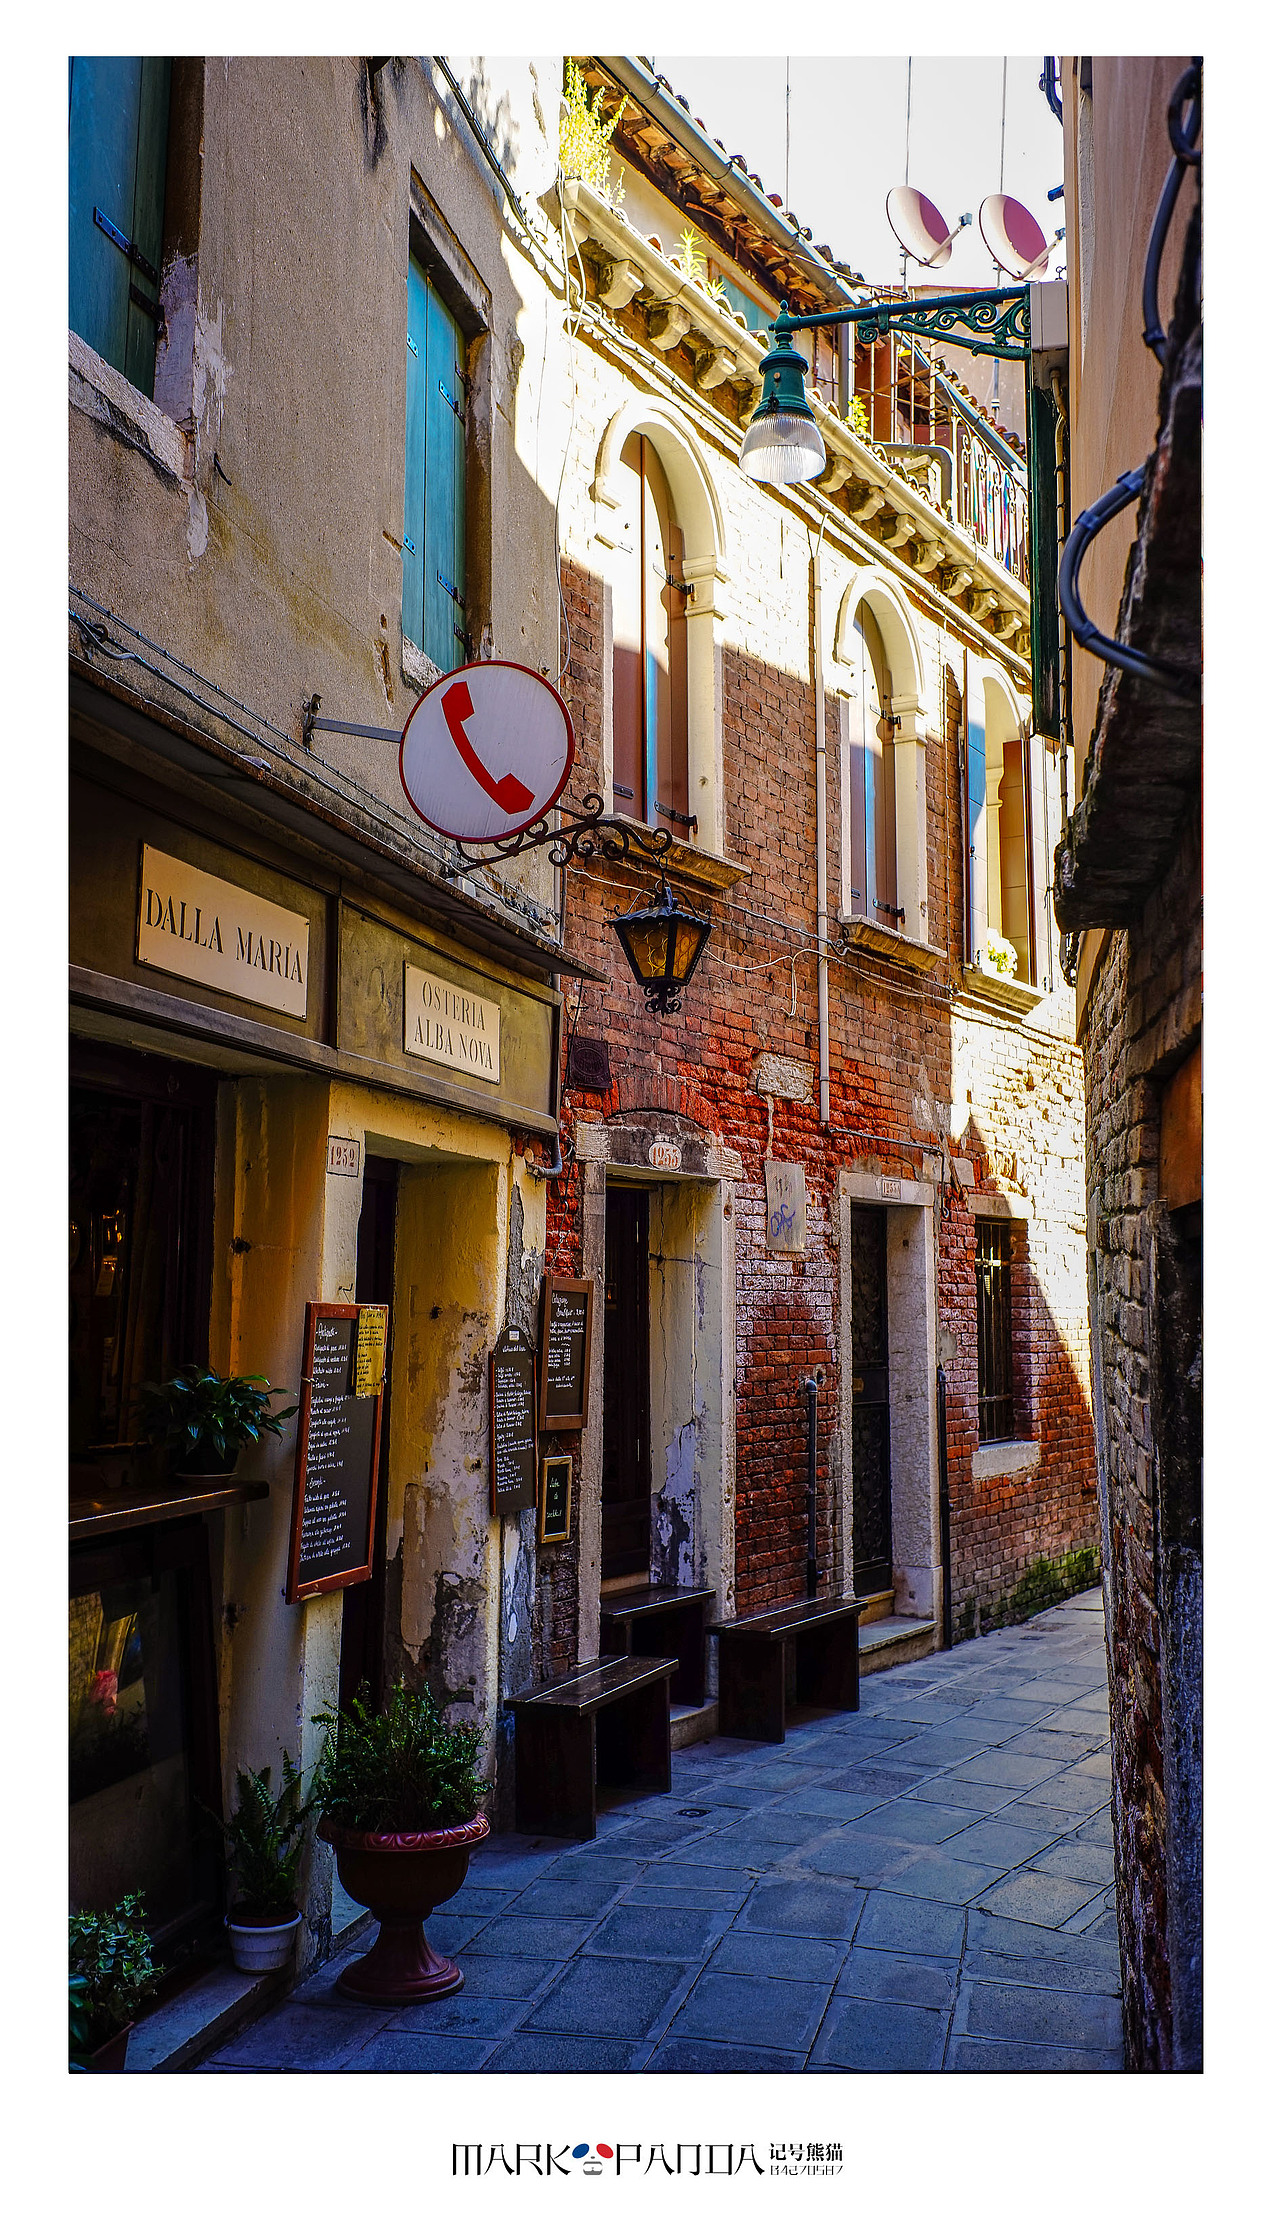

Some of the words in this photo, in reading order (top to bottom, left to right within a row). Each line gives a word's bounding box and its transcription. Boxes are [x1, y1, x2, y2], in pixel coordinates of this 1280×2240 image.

[146, 889, 224, 954] DALLA
[422, 981, 485, 1031] OSTERIA
[414, 1016, 453, 1055] ALBA
[459, 1033, 493, 1069] NOVA
[331, 1146, 355, 1167] 1252
